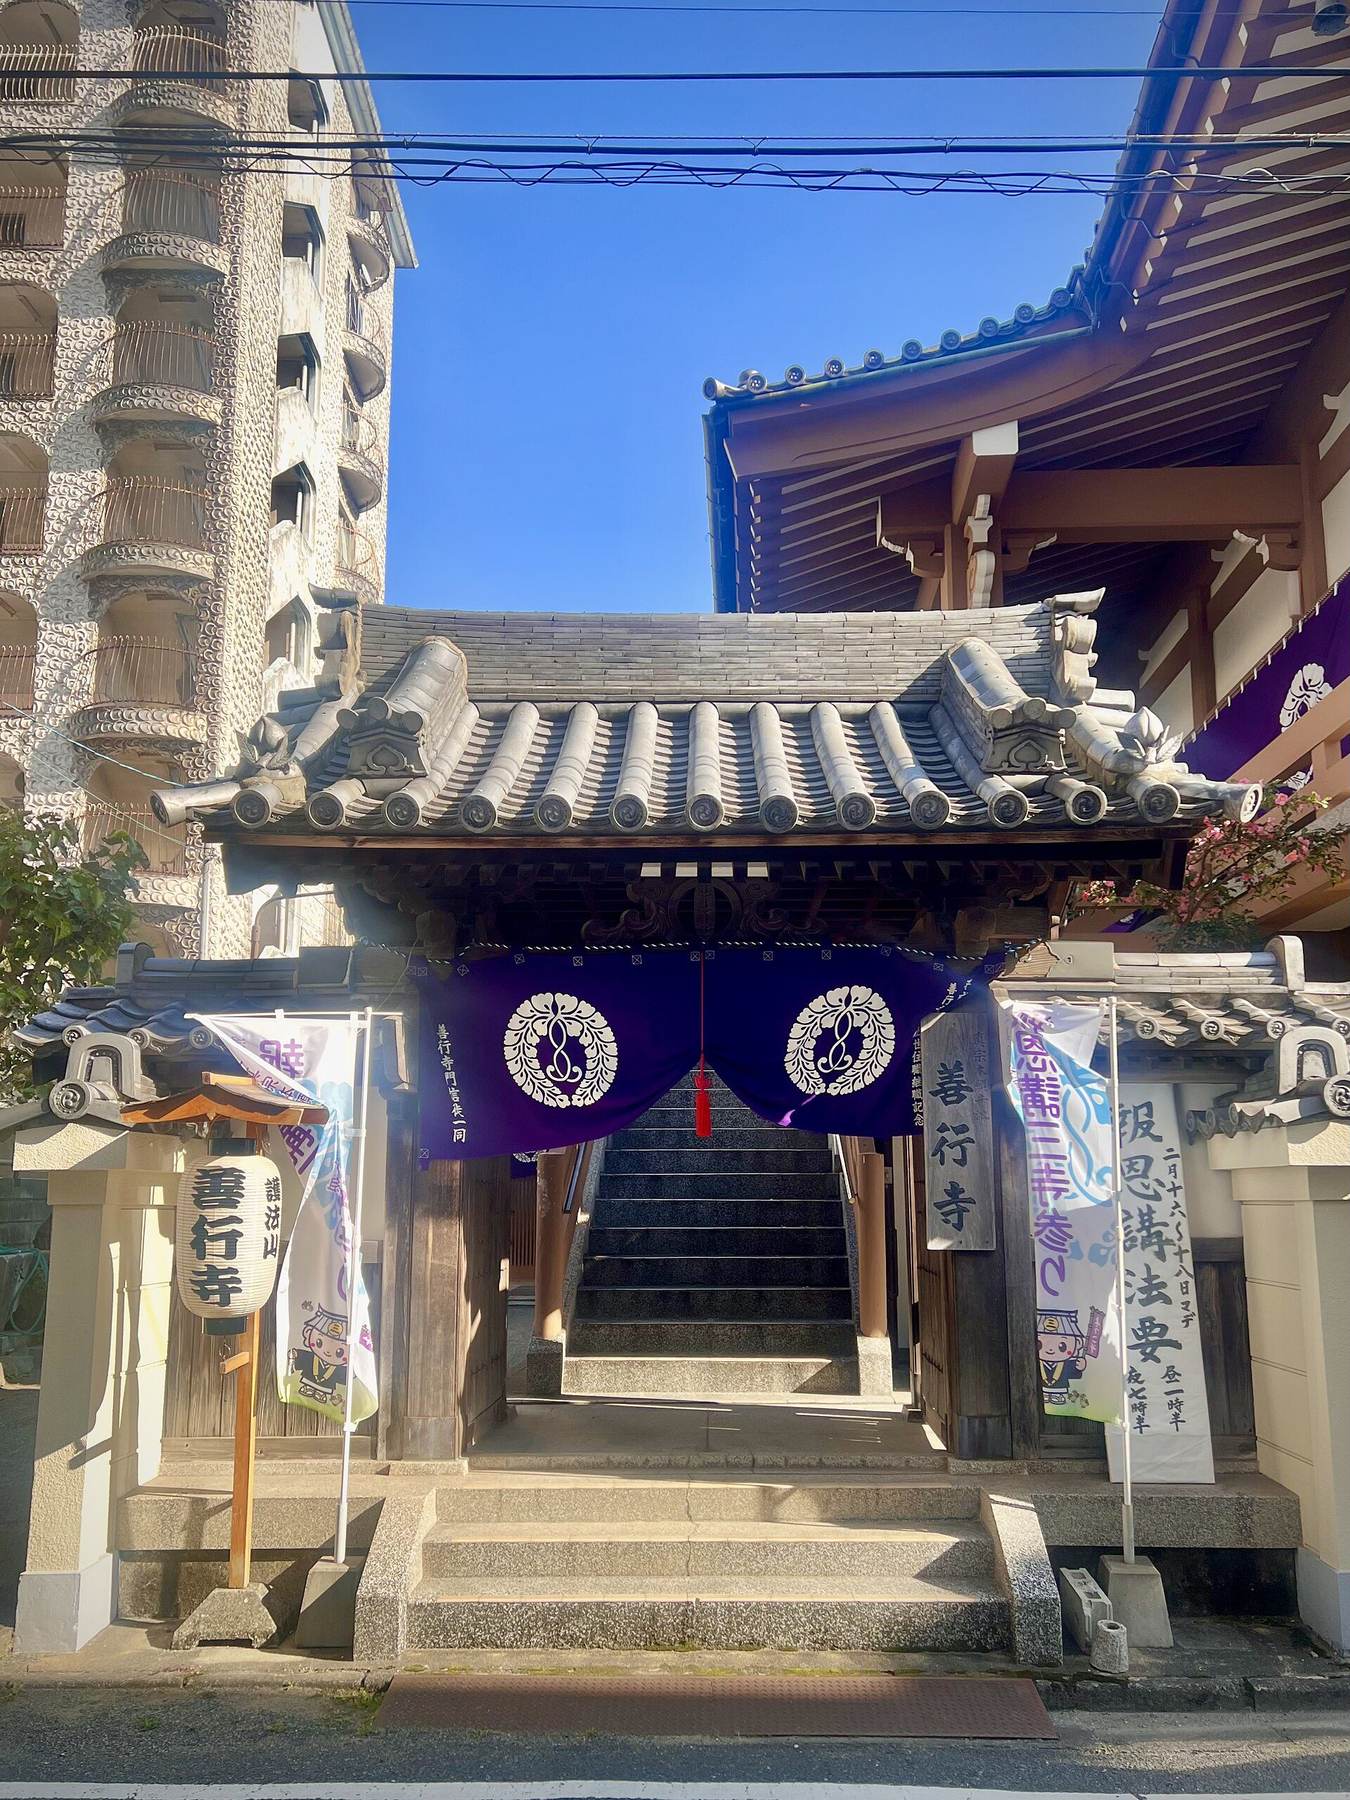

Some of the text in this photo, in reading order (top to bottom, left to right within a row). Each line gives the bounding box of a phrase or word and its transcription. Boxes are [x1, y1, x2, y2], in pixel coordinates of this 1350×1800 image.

[929, 1060, 976, 1232] 善行寺
[189, 1165, 246, 1307] 善行寺
[263, 1176, 281, 1260] 護法山
[1111, 1101, 1182, 1364] 報恩講法要
[1161, 1364, 1186, 1432] 昼一時半
